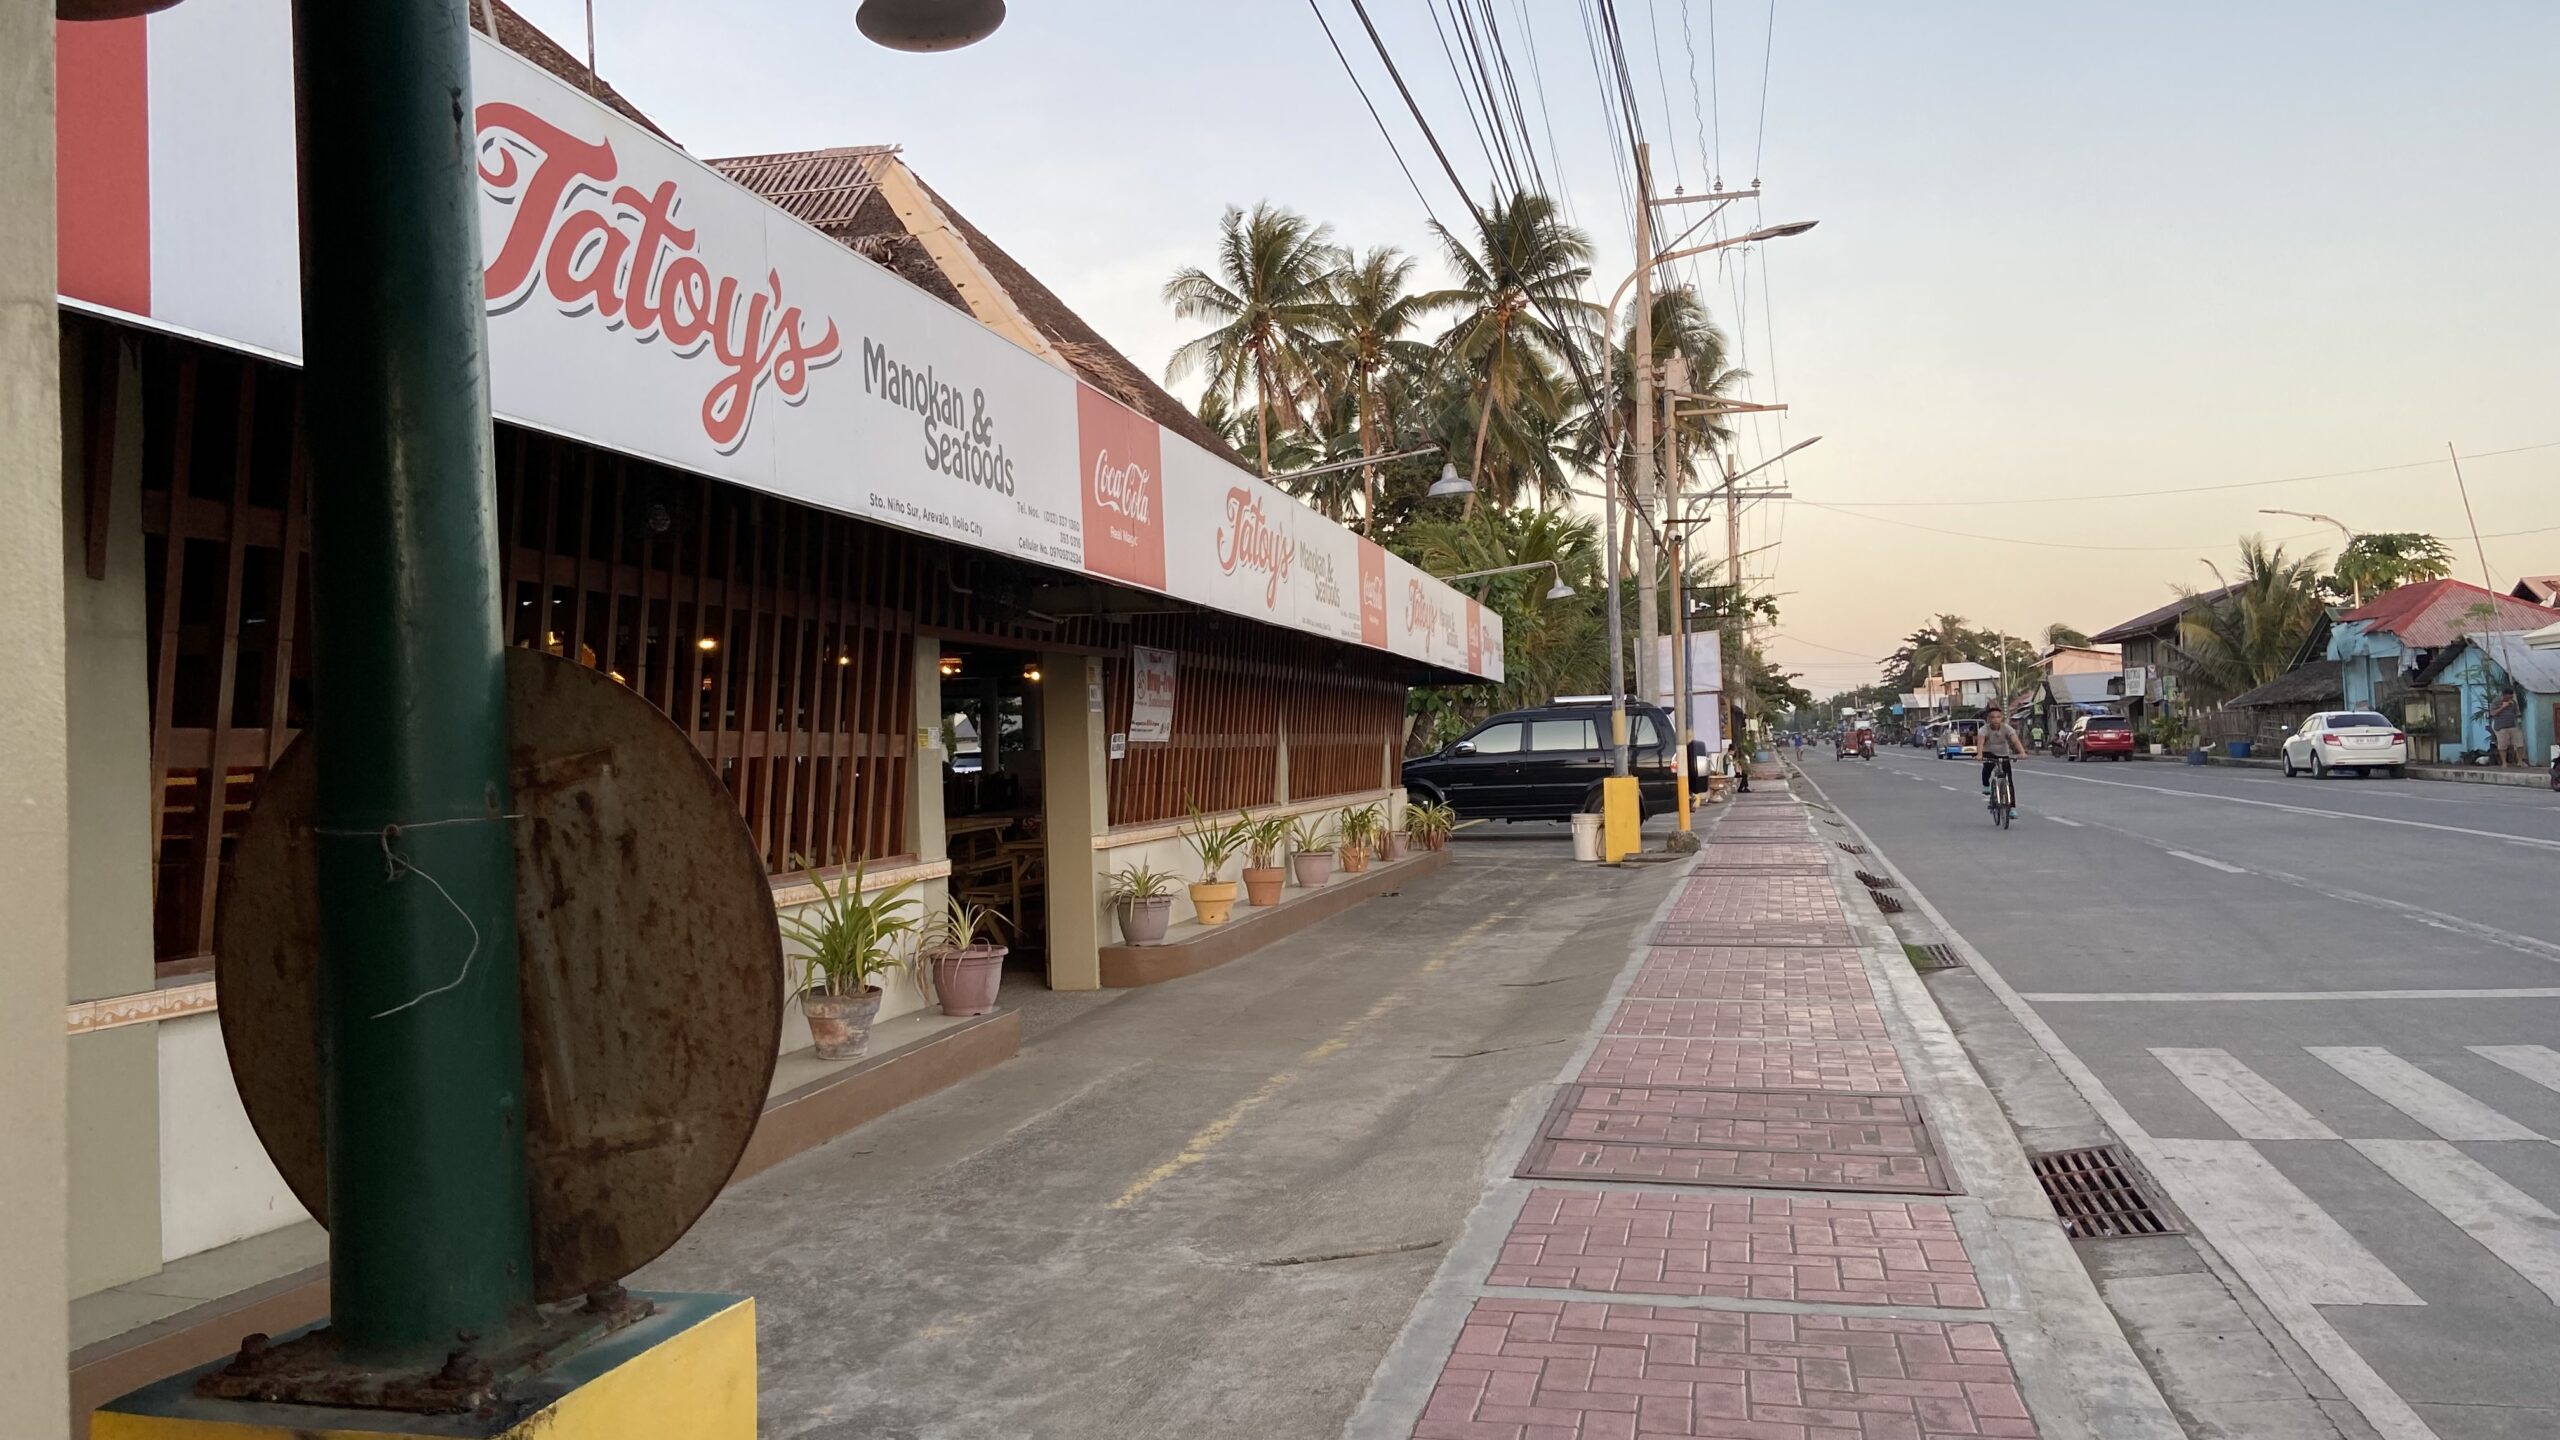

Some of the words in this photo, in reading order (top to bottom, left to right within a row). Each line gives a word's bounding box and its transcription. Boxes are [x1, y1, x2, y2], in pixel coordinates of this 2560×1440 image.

[475, 102, 842, 450] Tatoy's
[863, 336, 965, 431] Manokan
[972, 387, 993, 448] &
[924, 415, 1015, 497] Seafoods
[1094, 449, 1150, 524] Coca-Cola
[869, 492, 886, 508] Sto.
[887, 497, 905, 514] Niño
[906, 502, 921, 521] Sur,
[922, 507, 952, 529] Arevalo,
[952, 516, 969, 533] Iloilo
[970, 520, 983, 538] City
[1018, 536, 1039, 552] Cellular
[1216, 486, 1295, 611] Tatoy's
